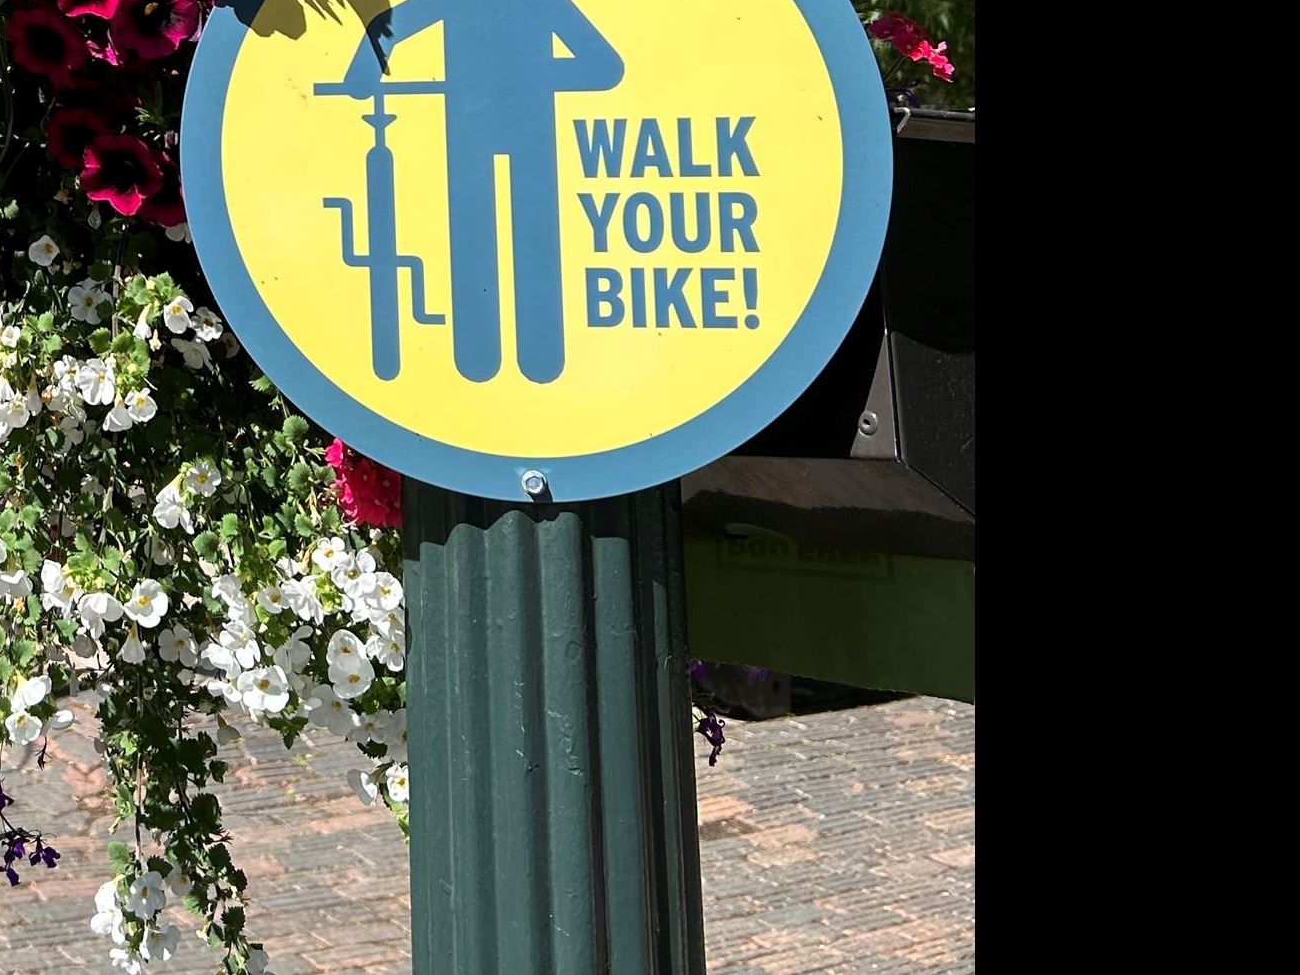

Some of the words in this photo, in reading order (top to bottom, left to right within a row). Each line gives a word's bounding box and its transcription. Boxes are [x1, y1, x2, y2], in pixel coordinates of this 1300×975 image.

[572, 116, 761, 178] WALK
[576, 192, 761, 254] YOUR
[585, 267, 761, 330] BIKE!
